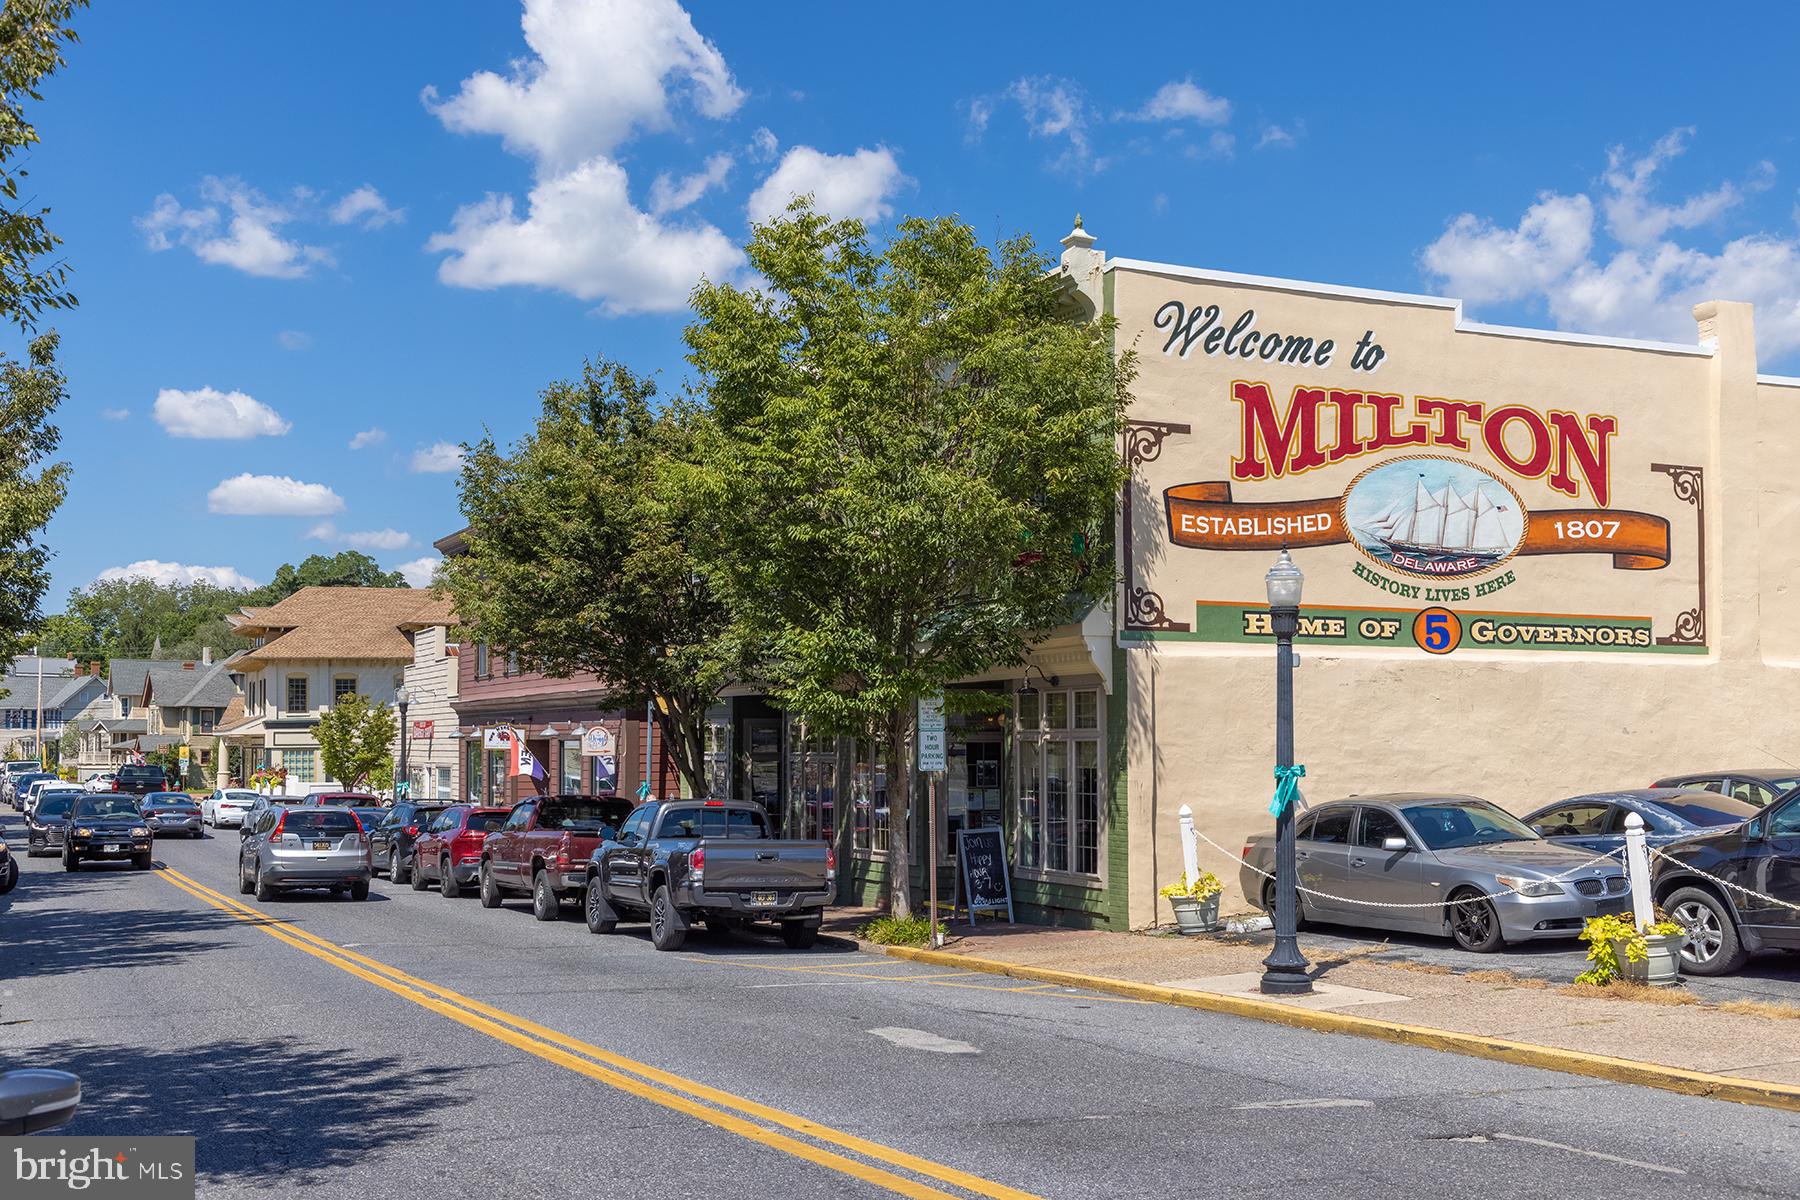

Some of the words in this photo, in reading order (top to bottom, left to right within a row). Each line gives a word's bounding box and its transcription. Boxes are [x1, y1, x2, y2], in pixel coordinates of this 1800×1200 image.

[1153, 300, 1335, 367] Welcome
[1350, 330, 1386, 371] to
[1230, 379, 1618, 507] MILTON
[1181, 513, 1332, 536] ESTABLISHED
[1554, 520, 1621, 539] 1807
[1352, 561, 1421, 599] HISTORY
[1425, 587, 1470, 602] LIVES
[1475, 570, 1516, 598] HERE
[1392, 552, 1478, 573] DELAWARE
[1243, 612, 1346, 638] HME
[1359, 619, 1400, 638] OF
[1425, 614, 1451, 650] 5
